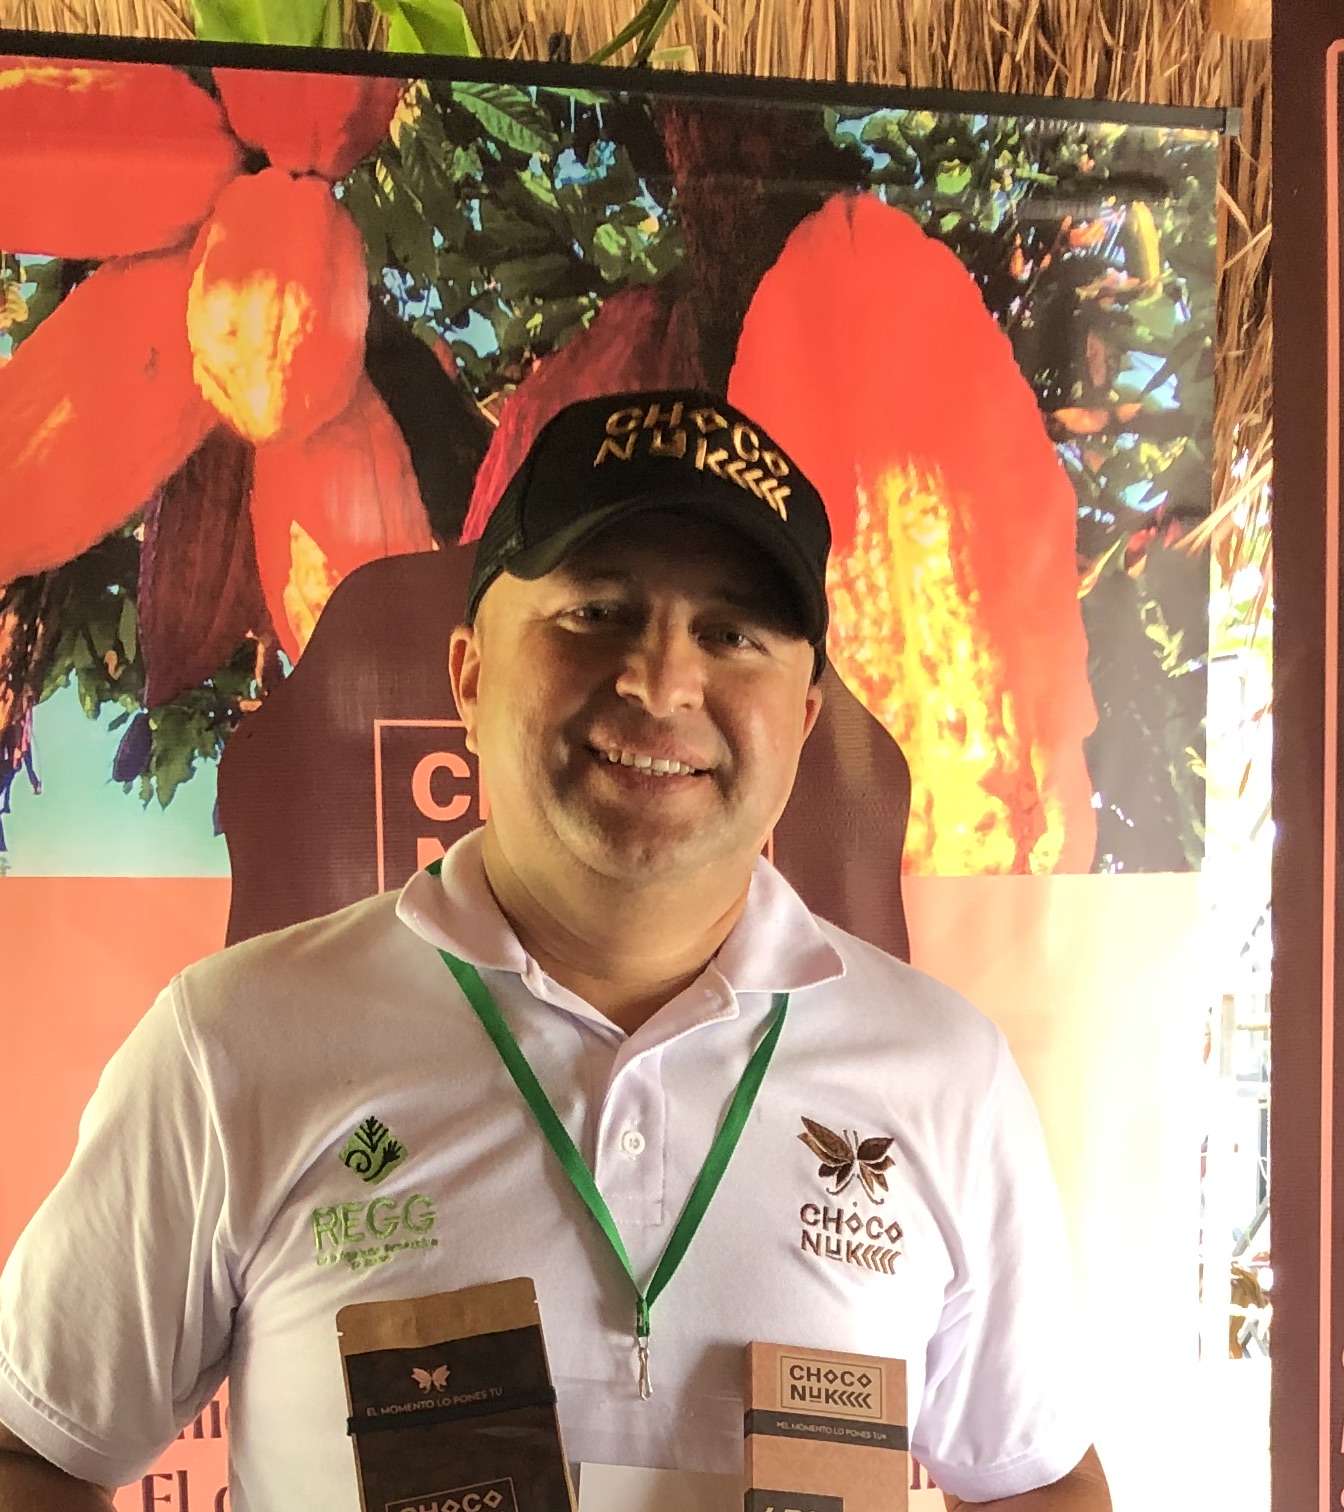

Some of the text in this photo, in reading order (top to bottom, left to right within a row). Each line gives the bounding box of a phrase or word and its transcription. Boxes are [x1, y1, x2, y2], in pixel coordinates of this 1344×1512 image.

[311, 1194, 435, 1250] REGG
[799, 1201, 904, 1245] CHOCO
[789, 1364, 872, 1388] CHOCO
[366, 1406, 379, 1417] EL
[381, 1399, 435, 1416] MOMENTO
[436, 1397, 452, 1409] LO
[453, 1390, 488, 1407] PONES
